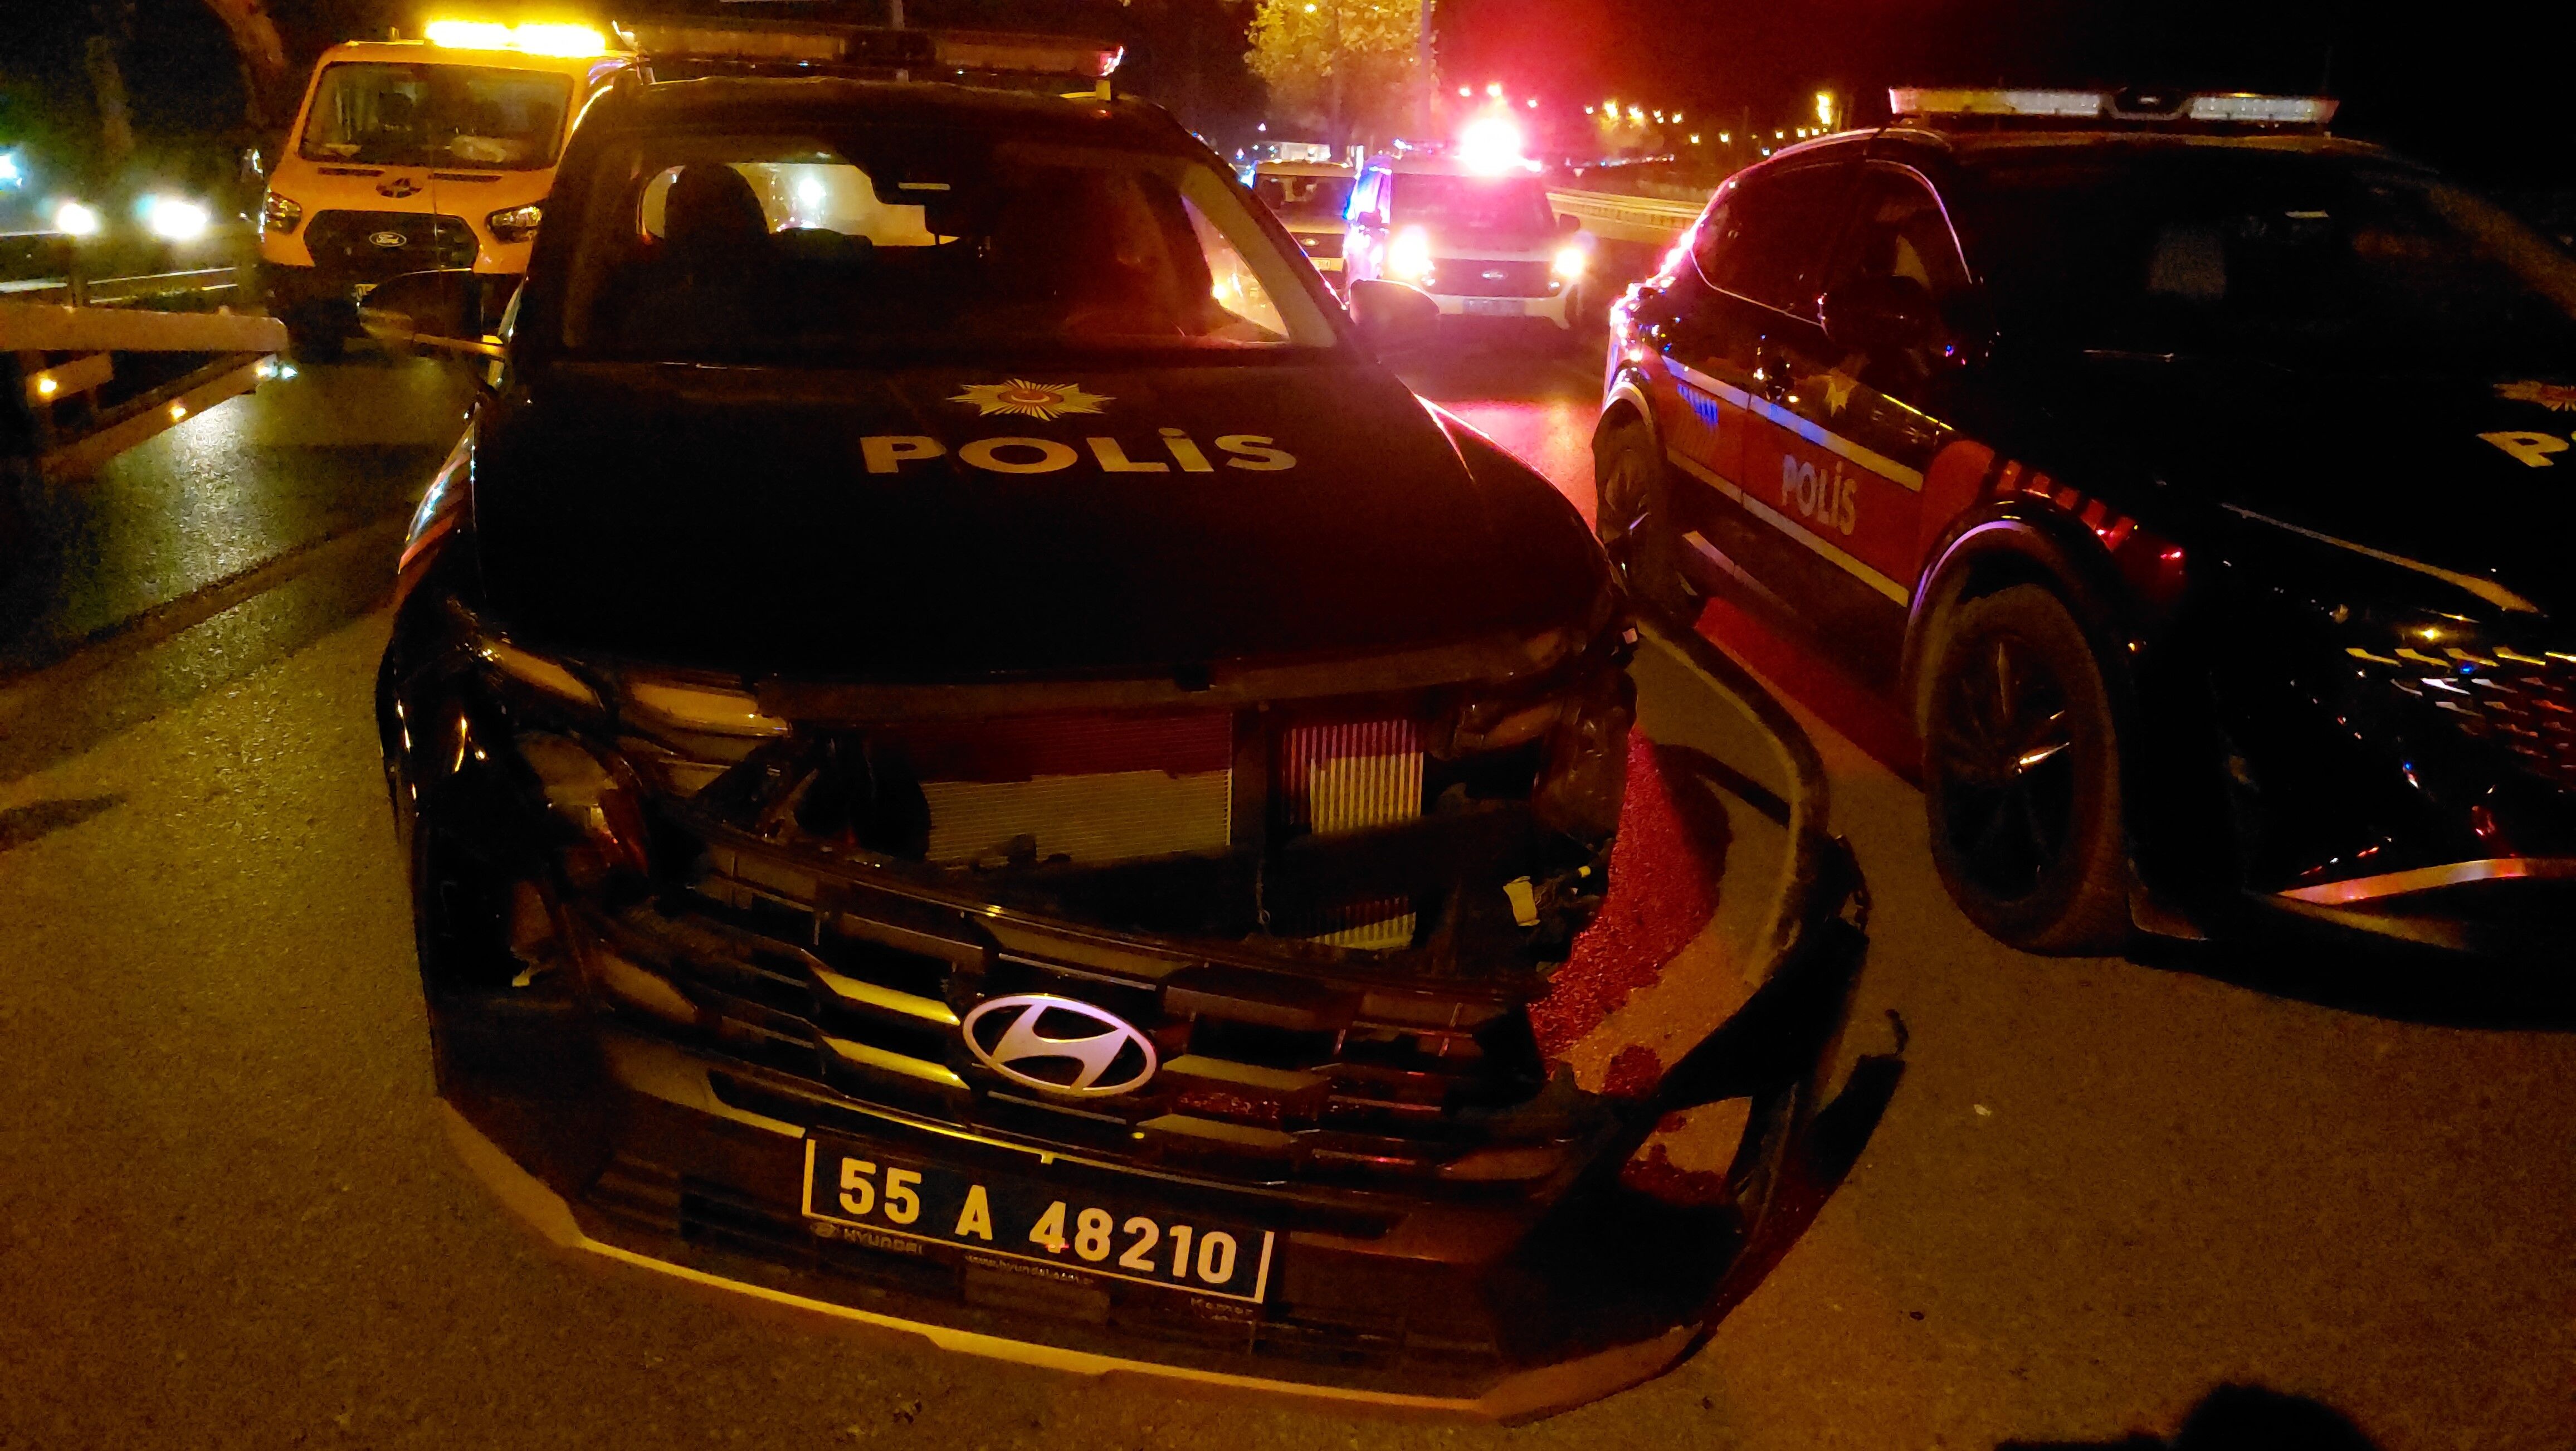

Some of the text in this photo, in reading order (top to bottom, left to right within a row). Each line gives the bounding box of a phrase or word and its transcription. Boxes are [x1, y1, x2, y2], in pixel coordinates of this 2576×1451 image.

[838, 1157, 1237, 1284] 55 A 48210
[843, 1228, 924, 1255] HYUNDAI
